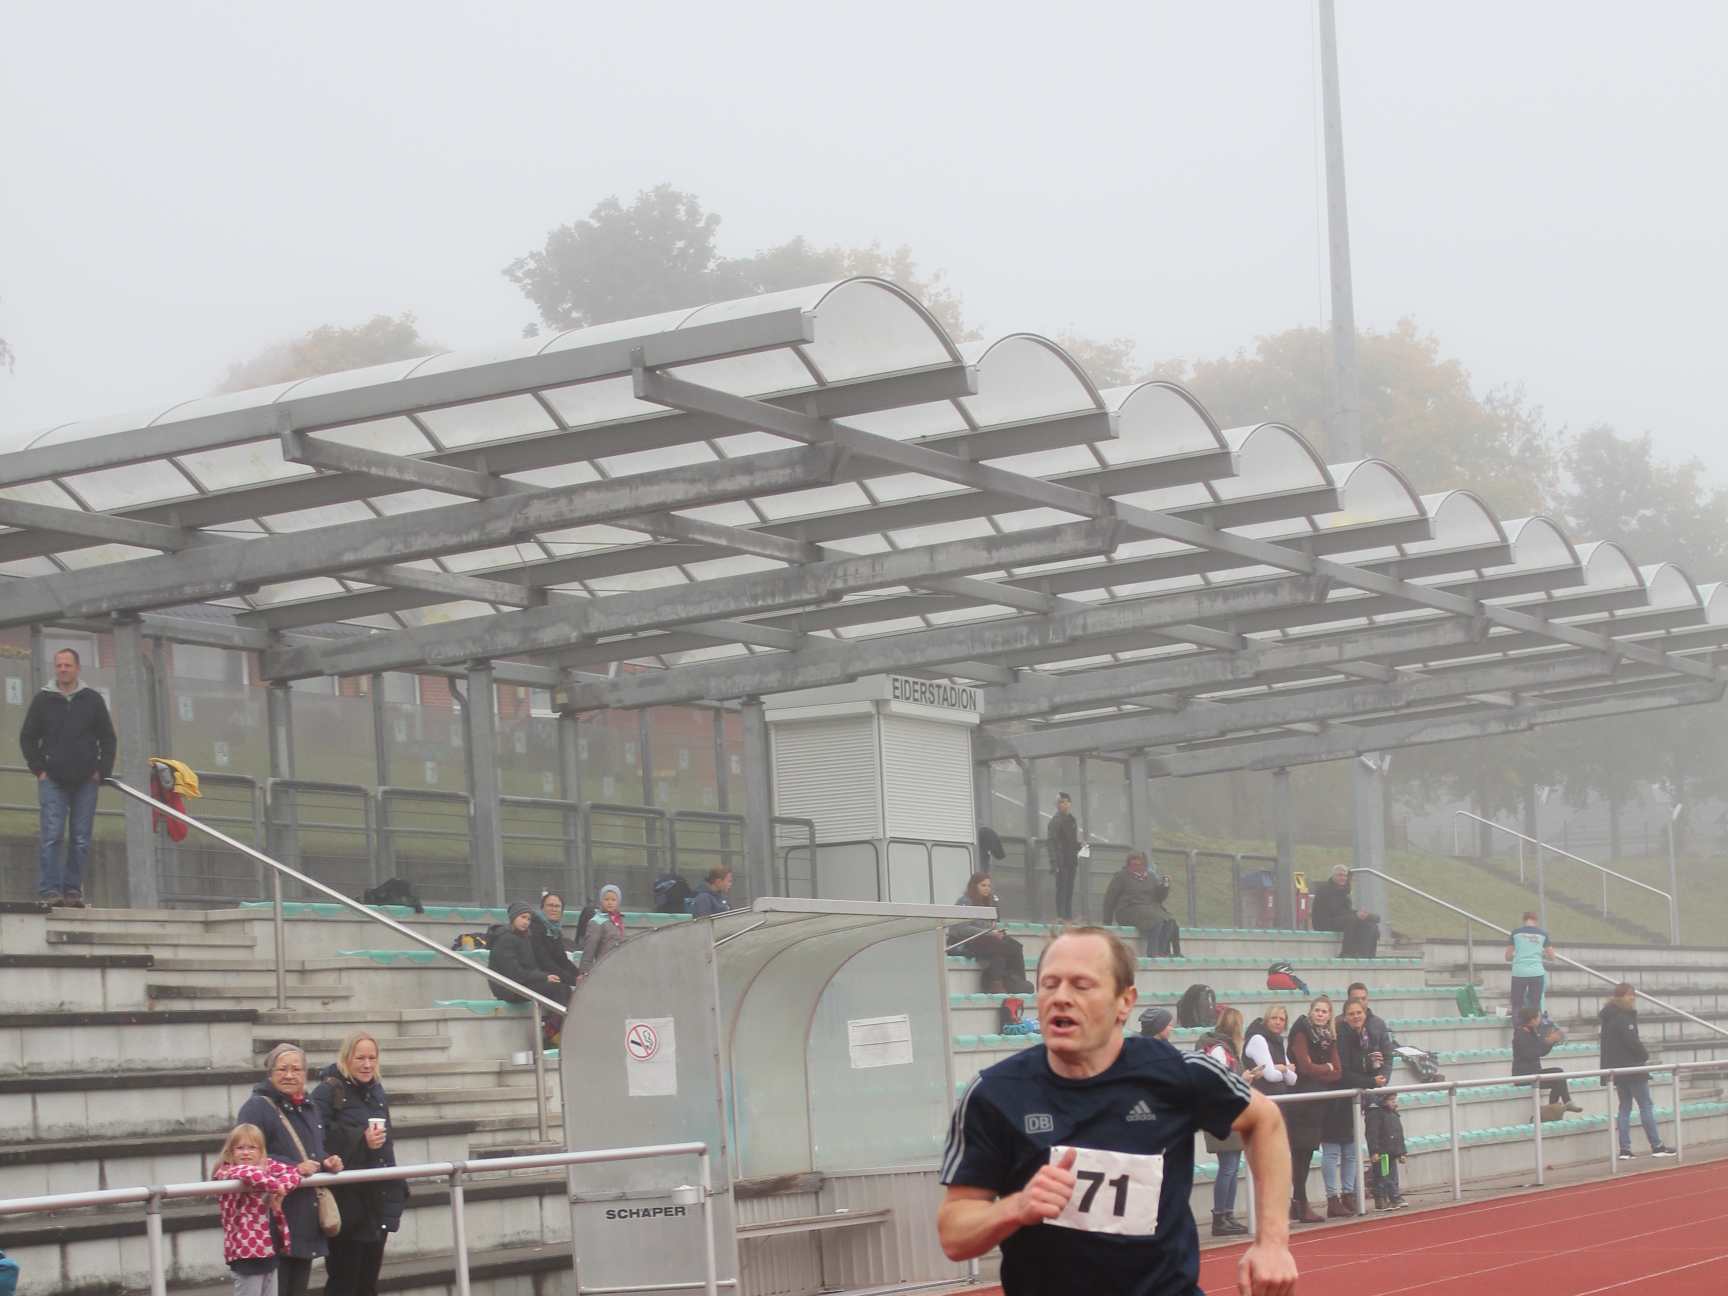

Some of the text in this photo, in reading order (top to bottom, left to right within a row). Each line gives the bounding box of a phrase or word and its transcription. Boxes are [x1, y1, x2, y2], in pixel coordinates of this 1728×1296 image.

[892, 678, 977, 711] EIDERSTADION
[1029, 1116, 1051, 1131] DB
[1077, 1170, 1129, 1217] 71
